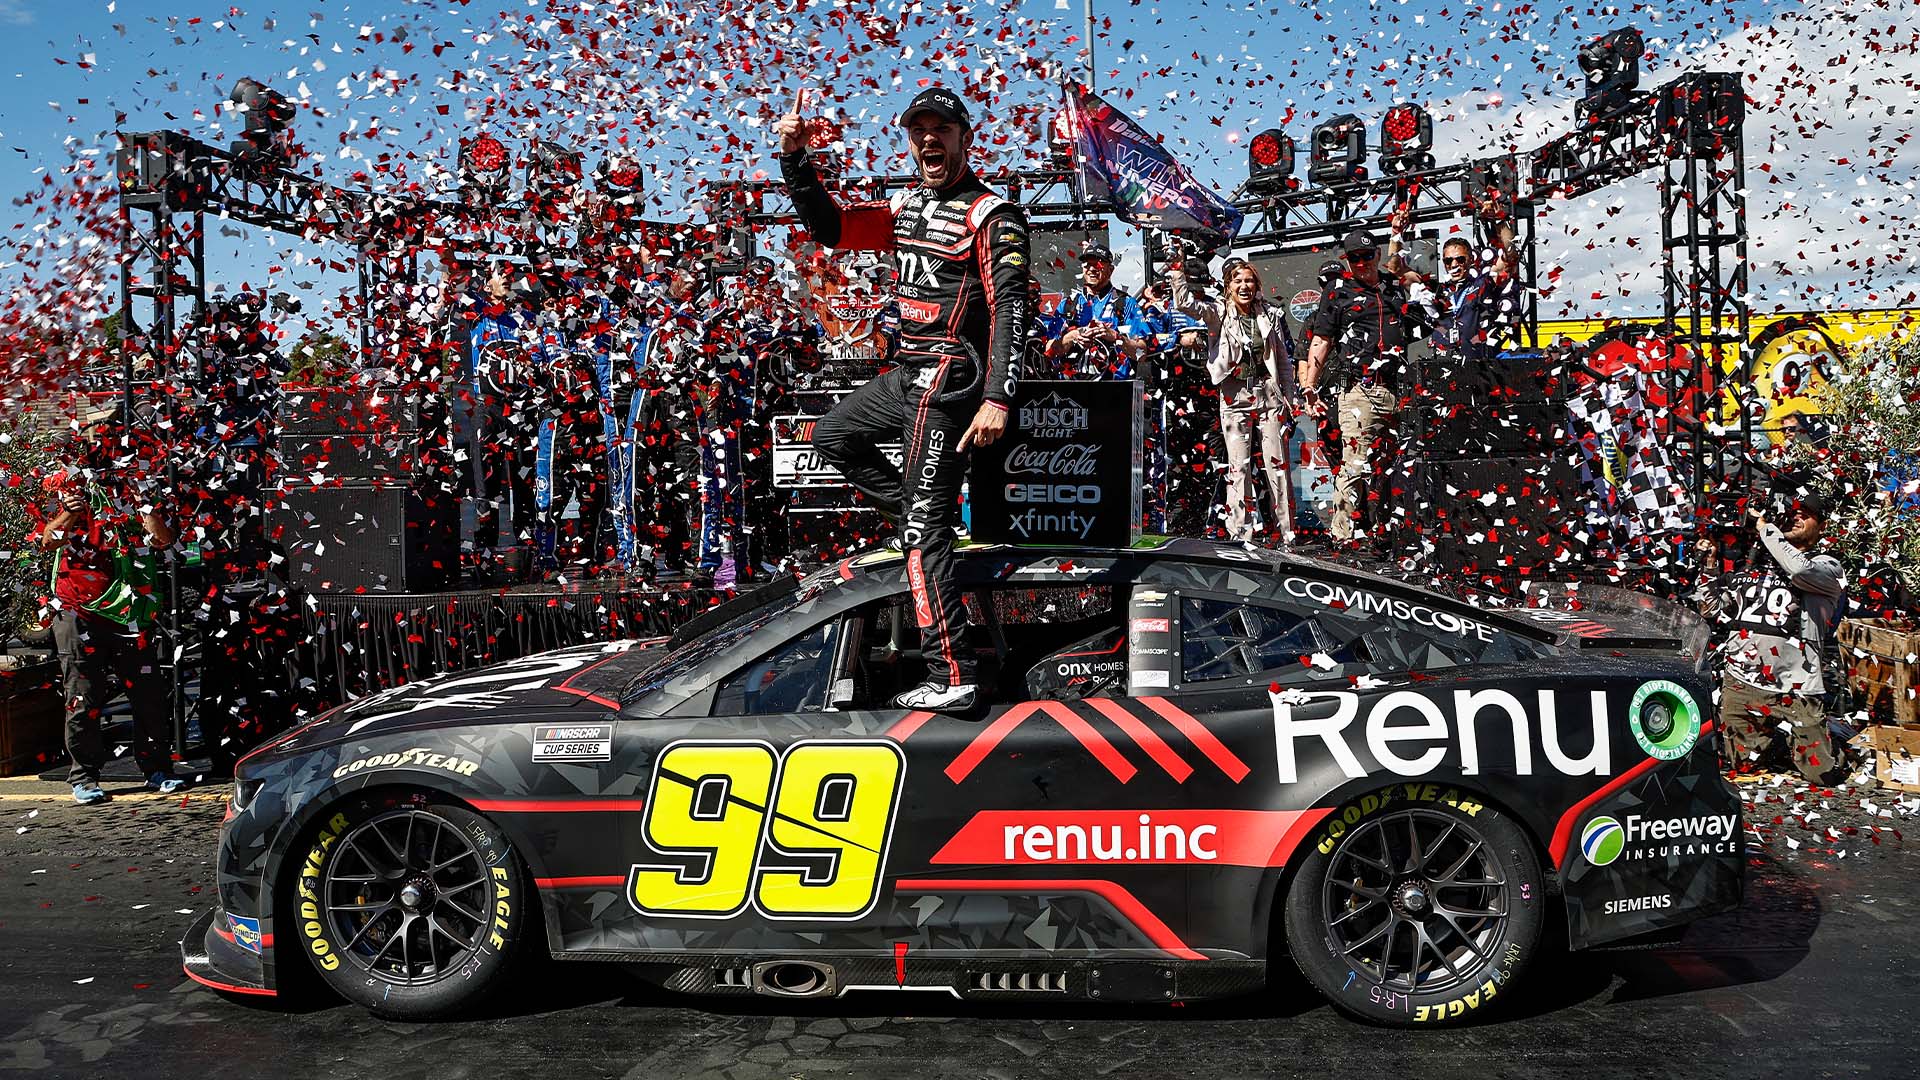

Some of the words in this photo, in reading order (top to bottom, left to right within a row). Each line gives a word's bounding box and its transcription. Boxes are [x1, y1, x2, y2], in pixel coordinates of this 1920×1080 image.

[934, 94, 955, 106] onx
[1116, 143, 1185, 193] WIN
[843, 308, 868, 318] 350
[901, 302, 932, 321] Renu
[1012, 299, 1024, 345] HOMES
[1019, 407, 1089, 430] BUSCH
[1033, 428, 1073, 438] LIGHT
[918, 428, 945, 491] HOMES
[1004, 443, 1103, 476] Coca-Cola
[1005, 484, 1101, 504] GEICO
[1009, 508, 1096, 540] xfinity
[911, 556, 922, 590] Renu
[1283, 577, 1495, 644] COMMSCOPE
[1058, 662, 1092, 676] onx
[1094, 661, 1125, 672] HOMES
[543, 744, 563, 755] CUP
[565, 743, 600, 754] SERIES
[559, 728, 600, 739] NASCAR
[1268, 688, 1612, 784] Renu
[333, 747, 480, 778] GOODYEAR
[627, 739, 907, 921] 99
[1317, 783, 1484, 855] GOODYEAR
[1626, 814, 1737, 843] Freeway
[1003, 814, 1217, 861] renu.inc
[1626, 841, 1737, 861] INSURANCE
[299, 812, 350, 971] GOODYEAR
[1520, 883, 1531, 900] 53
[1603, 894, 1672, 915] SIEMENS
[489, 866, 511, 951] EAGLE
[232, 925, 260, 940] SUNOCO
[1413, 978, 1499, 1023] EAGLE
